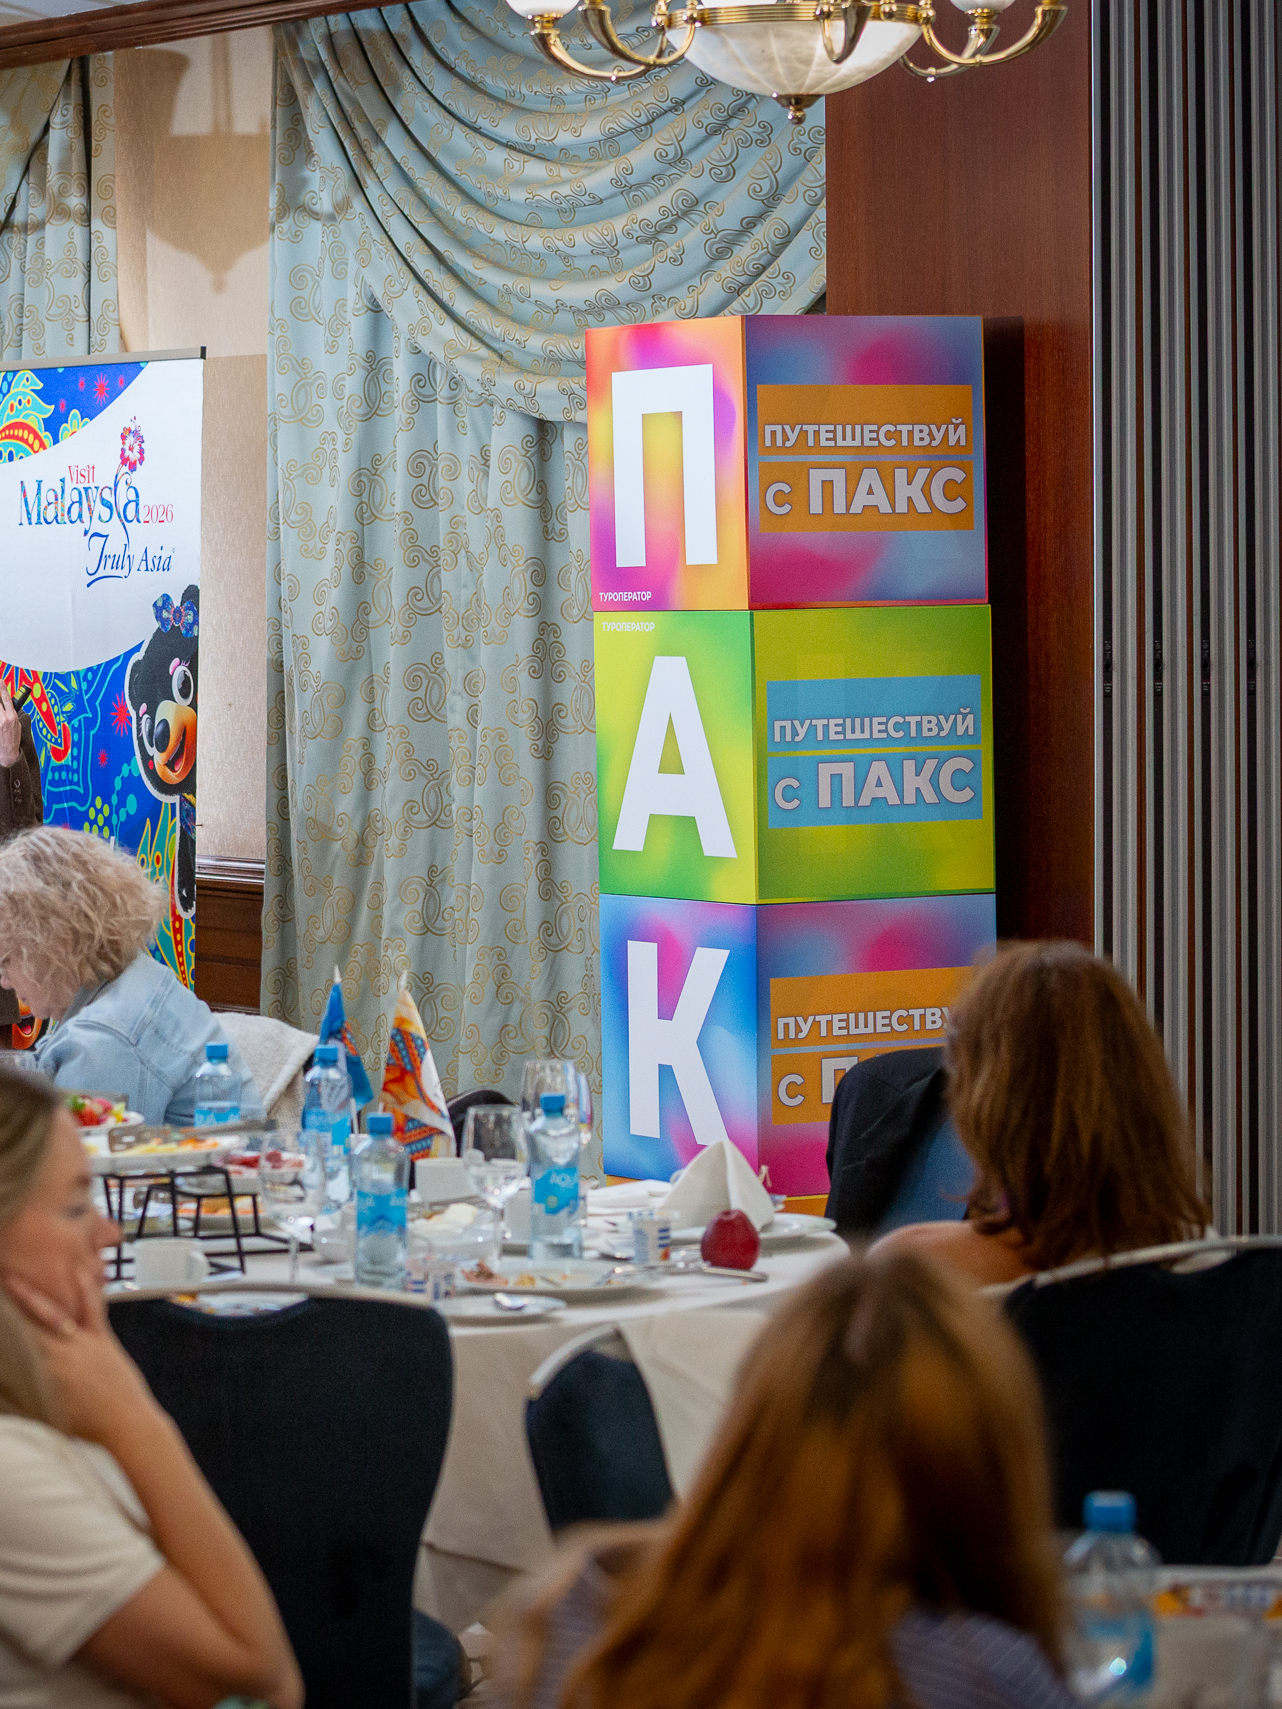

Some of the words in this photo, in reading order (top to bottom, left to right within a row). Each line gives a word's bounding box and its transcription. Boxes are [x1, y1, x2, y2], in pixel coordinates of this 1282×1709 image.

[763, 417, 967, 448] ПУТЕШЕСТВУЙ
[68, 464, 96, 485] Visit
[611, 363, 718, 568] П
[808, 466, 968, 515] ПАКС
[143, 504, 174, 524] 2026
[85, 531, 135, 580] Truly
[136, 545, 173, 572] Asia
[599, 591, 652, 602] ТУРОПЕРАТОР
[602, 622, 655, 632] ТУРОПЕРАТОР
[772, 707, 975, 743] ПУТЕШЕСТВУЙ
[612, 655, 738, 858] А
[817, 756, 977, 809] ПАКС
[777, 1006, 951, 1041] ПУТЕШЕСТВ
[627, 940, 731, 1147] К
